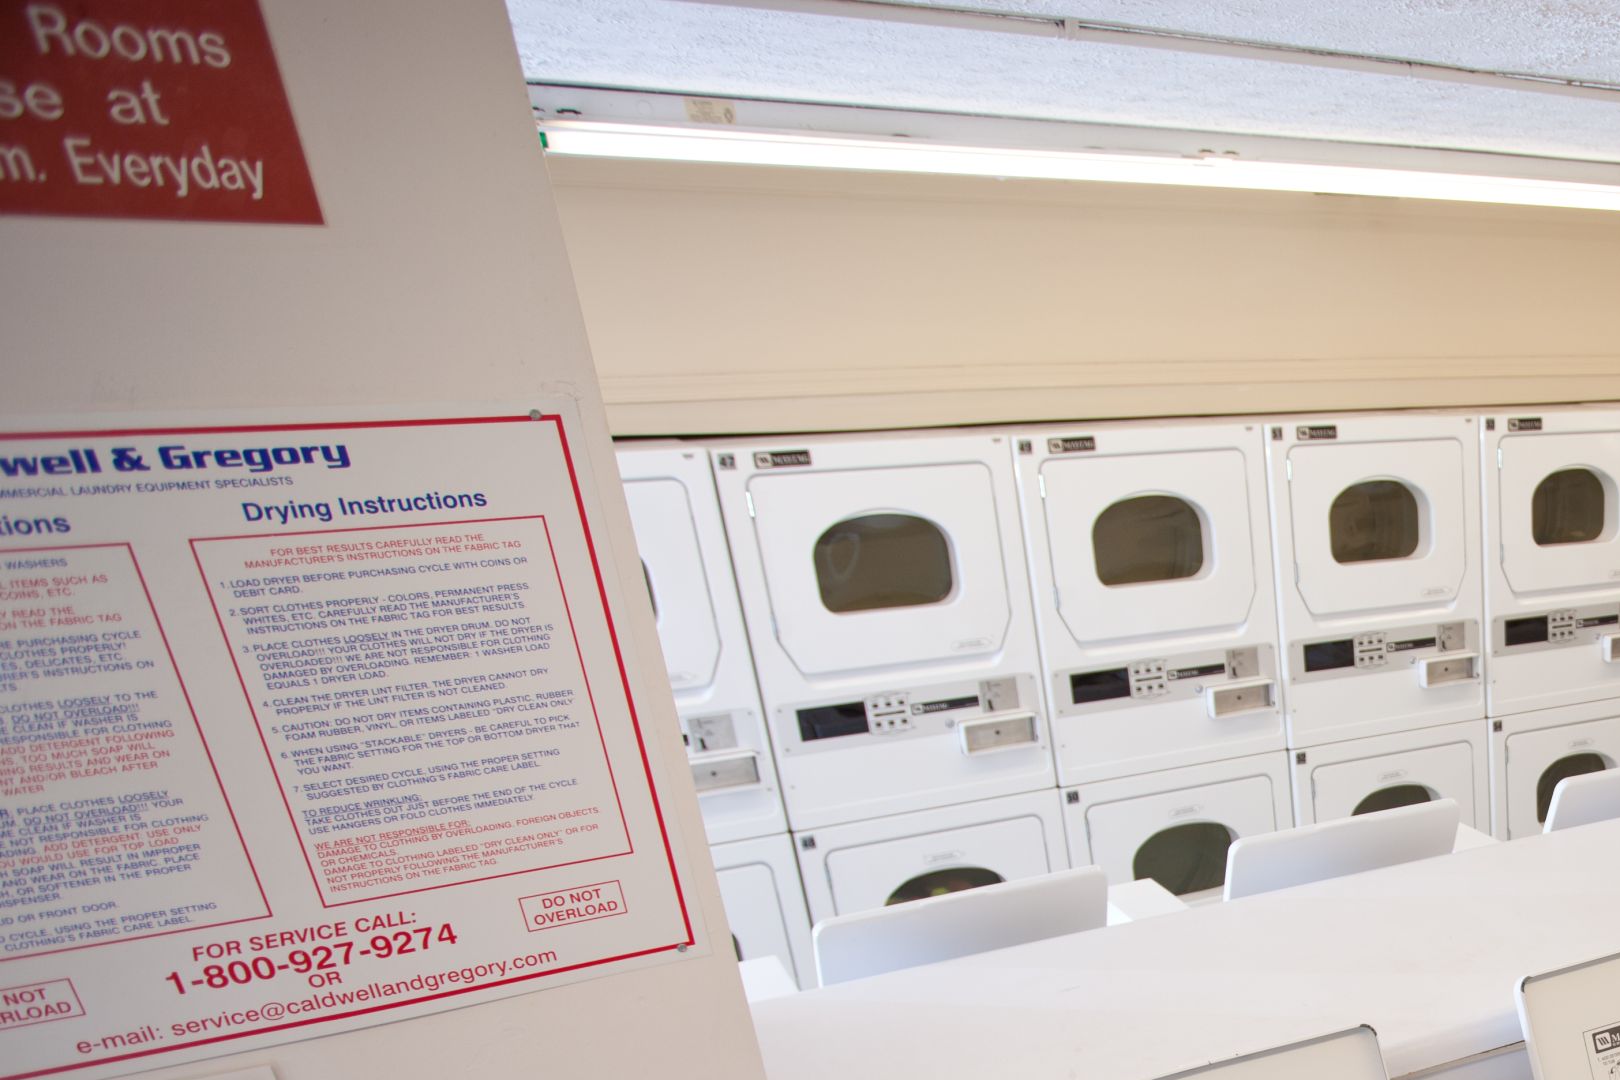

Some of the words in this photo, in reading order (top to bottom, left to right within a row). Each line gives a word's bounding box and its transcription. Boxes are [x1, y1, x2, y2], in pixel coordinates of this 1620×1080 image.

[27, 3, 231, 69] Rooms
[107, 79, 170, 126] at
[64, 137, 265, 201] Everyday
[0, 448, 102, 476] well
[111, 447, 150, 472] &
[158, 444, 351, 472] Gregory
[70, 483, 131, 495] LAUNDRY
[135, 479, 210, 492] EQUIPMENT
[214, 476, 293, 489] SPECIALISTS
[241, 500, 333, 524] Drying
[338, 491, 487, 515] Instructions
[244, 554, 344, 568] MANUFACTURER'S
[346, 547, 423, 560] INSTRUCTIONS
[424, 546, 440, 555] ON
[441, 544, 462, 552] THE
[463, 542, 500, 551] FABRIC
[501, 540, 521, 548] TAG
[270, 547, 293, 557] FOR
[295, 545, 323, 555] BEST
[326, 542, 374, 552] RESULTS
[375, 537, 432, 549] CAREFULLY
[434, 535, 462, 544] READ
[463, 533, 484, 541] THE
[229, 578, 260, 588] LOAD
[262, 575, 301, 585] DRYER
[302, 571, 346, 582] BEFORE
[347, 565, 416, 579] PURCHASING
[417, 562, 451, 573] CYCLE
[452, 560, 478, 569] WITH
[479, 557, 511, 567] COINS
[512, 556, 528, 565] OR
[233, 587, 266, 598] DEBIT
[268, 585, 303, 595] CARD.
[533, 900, 618, 925] OVERLOAD
[541, 895, 565, 909] DO
[569, 888, 600, 904] NOT
[192, 940, 242, 961] FOR
[249, 921, 348, 951] SERVICE
[354, 911, 416, 932] CALL:
[165, 923, 457, 994] 1-800-927-9274
[308, 970, 342, 988] OR
[3, 988, 46, 1006] NOT
[76, 1025, 163, 1053] e-mail:
[171, 950, 557, 1036] service@caldwellandgregory.com
[0, 1002, 71, 1024] RLOAD
